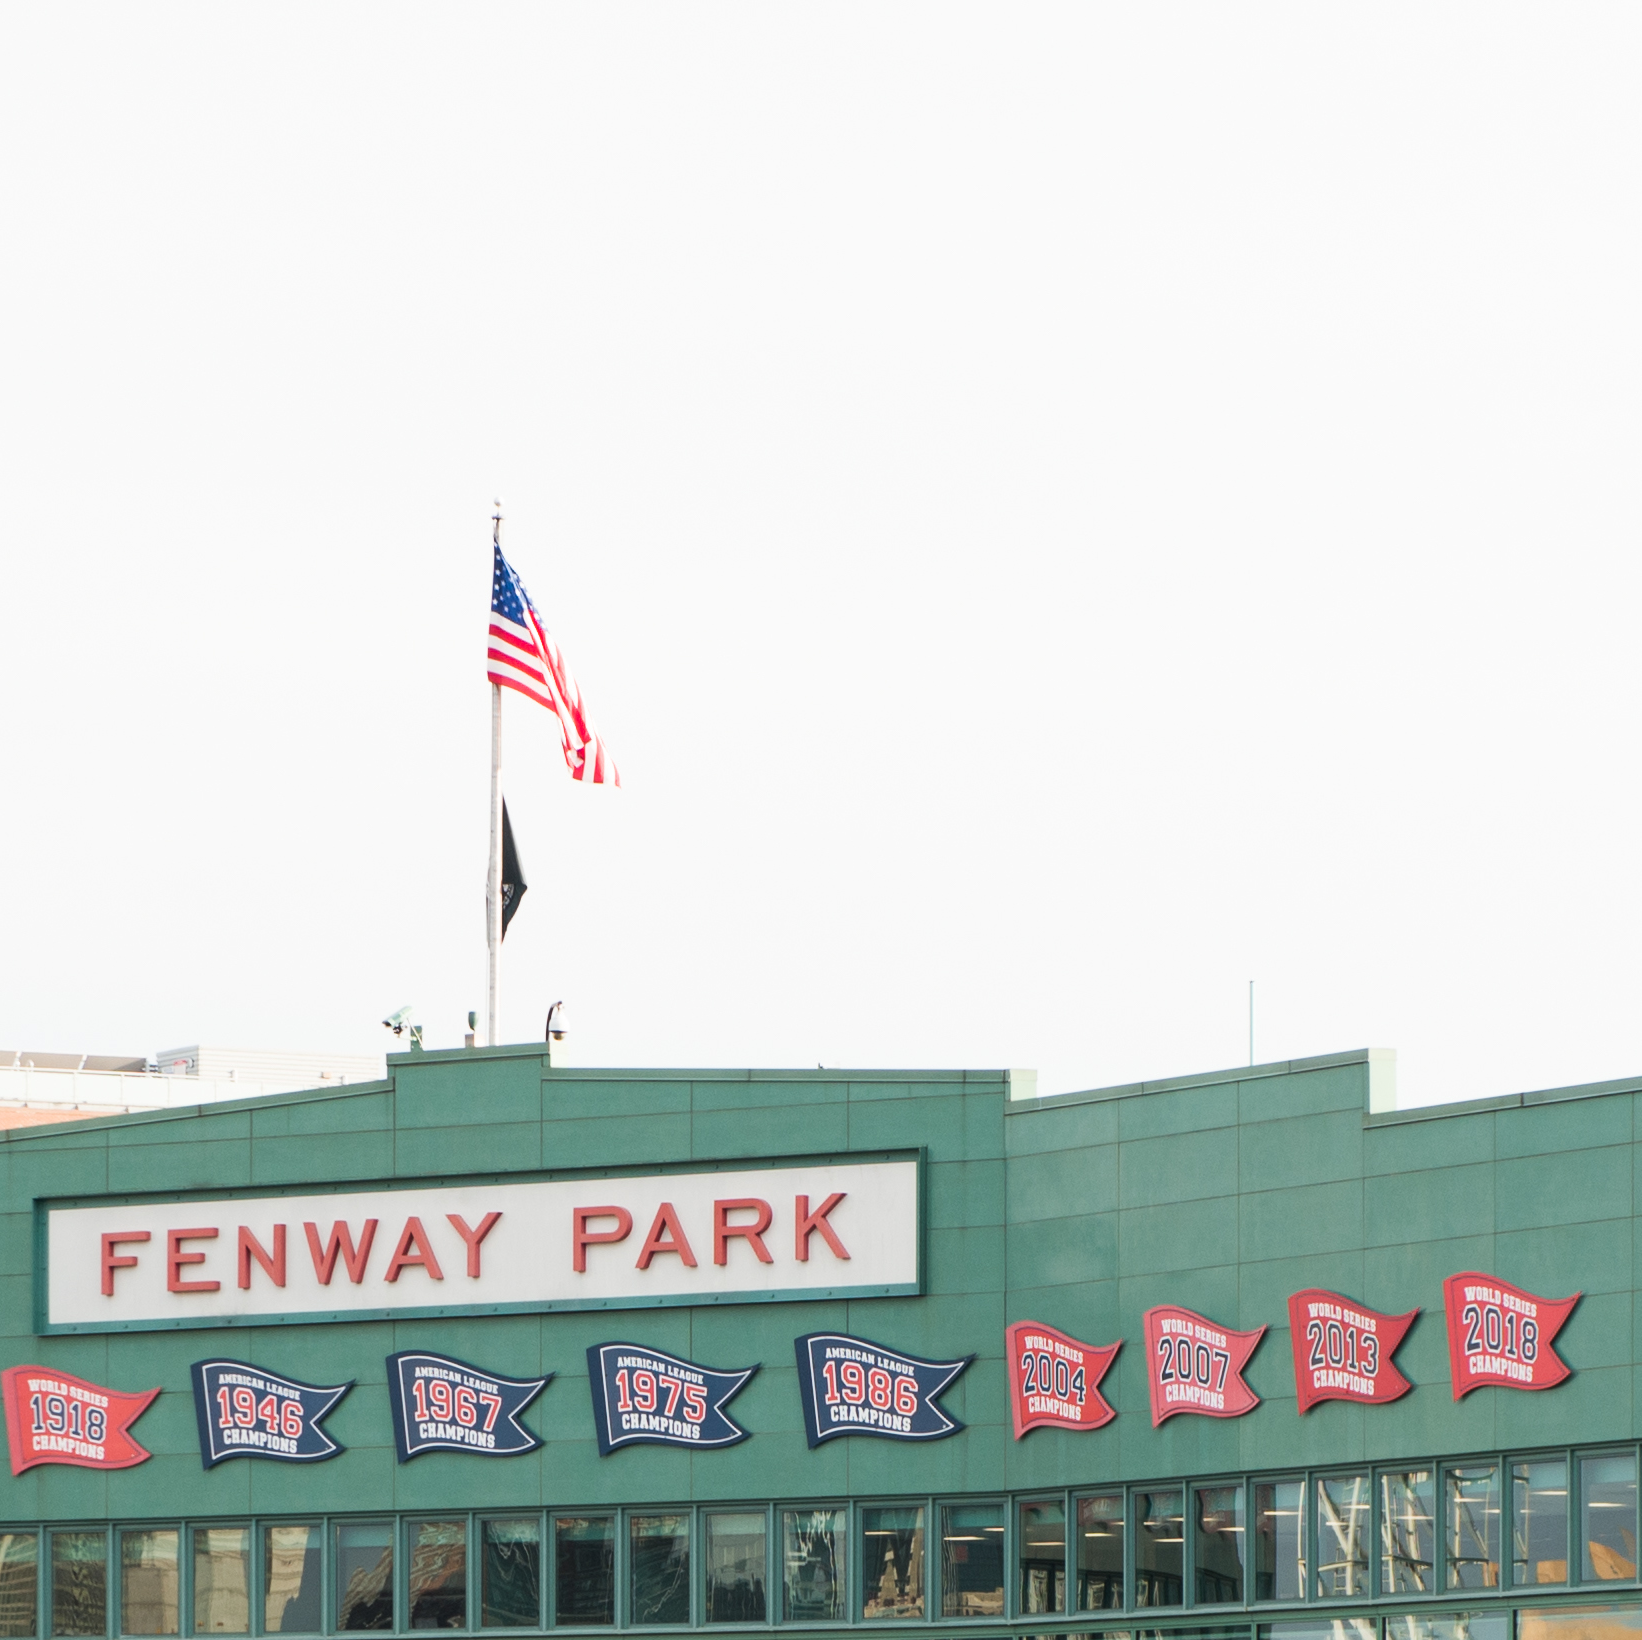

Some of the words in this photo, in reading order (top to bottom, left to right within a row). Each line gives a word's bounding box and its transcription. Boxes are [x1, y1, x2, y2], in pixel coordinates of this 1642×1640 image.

[100, 1211, 504, 1297] FENWAY
[571, 1191, 853, 1275] PARK
[1464, 1285, 1502, 1306] WORLD
[1502, 1293, 1538, 1318] SERIES
[1308, 1302, 1342, 1322] WORLD
[1343, 1309, 1376, 1333] SERIES
[1161, 1318, 1194, 1338] WORLD
[1194, 1325, 1227, 1348] SERIES
[1462, 1303, 1539, 1363] 2018
[825, 1347, 876, 1366] AMERICAN
[877, 1357, 915, 1376] LEAGUE
[1025, 1335, 1054, 1352] WORLD
[1054, 1341, 1084, 1364] SERIES
[1307, 1319, 1379, 1378] 2013
[616, 1356, 665, 1375] AMERICAN
[667, 1365, 704, 1385] LEAGUE
[1158, 1335, 1231, 1393] 2007
[1469, 1355, 1533, 1383] CHAMPIONS
[27, 1379, 69, 1397] WORLD
[70, 1387, 109, 1408] SERIES
[218, 1374, 264, 1392] AMERICAN
[266, 1382, 302, 1400] LEAGUE
[414, 1366, 462, 1384] AMERICAN
[463, 1375, 499, 1395] LEAGUE
[822, 1360, 919, 1417] 1986
[1022, 1352, 1086, 1406] 2004
[1313, 1369, 1375, 1397] CHAMPIONS
[412, 1379, 503, 1433] 1967
[615, 1368, 708, 1423] 1975
[1028, 1395, 1082, 1421] CHAMPIONS
[1165, 1383, 1225, 1410] CHAMPIONS
[29, 1394, 107, 1444] 1918
[217, 1385, 305, 1439] 1946
[621, 1412, 702, 1439] CHAMPIONS
[830, 1405, 912, 1432] CHAMPIONS
[32, 1434, 105, 1461] CHAMPIONS
[223, 1428, 298, 1454] CHAMPIONS
[419, 1422, 496, 1449] CHAMPIONS
